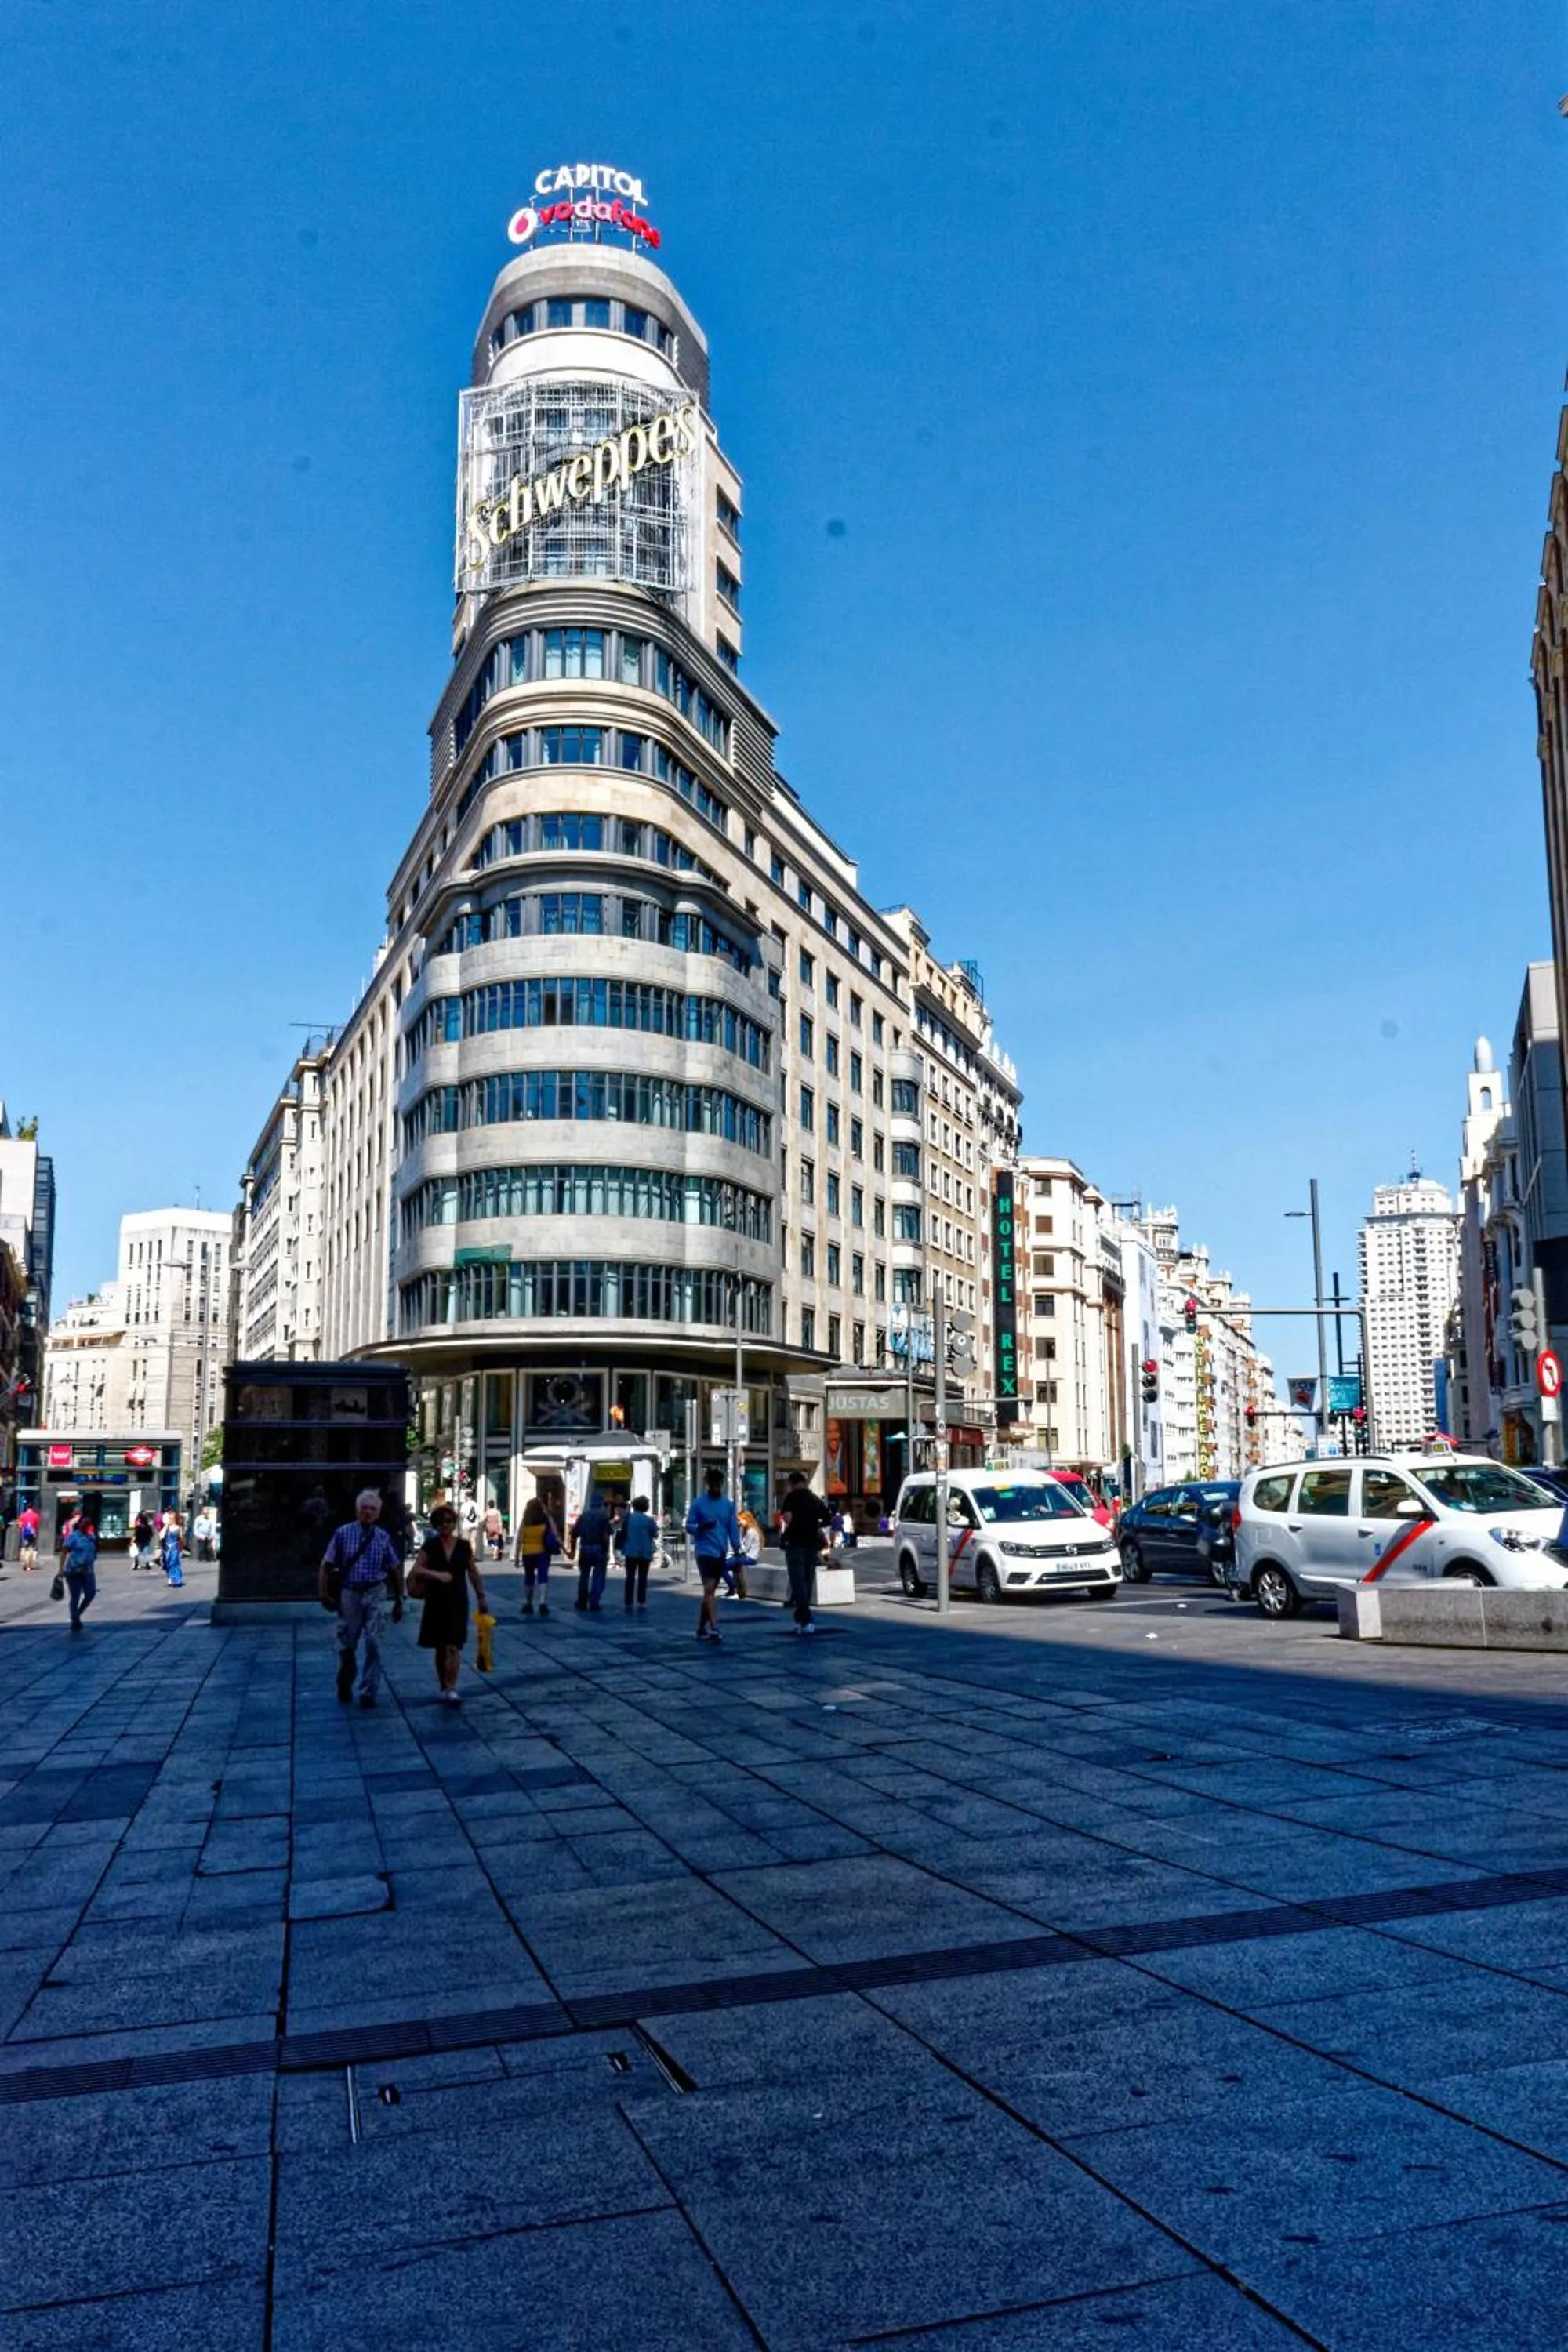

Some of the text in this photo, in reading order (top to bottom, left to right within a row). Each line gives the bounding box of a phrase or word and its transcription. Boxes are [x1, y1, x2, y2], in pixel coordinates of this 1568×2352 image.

[535, 164, 648, 206] CAPITOL
[539, 195, 662, 250] vodafone
[466, 397, 699, 572] Schweppes
[998, 1197, 1015, 1395] HOTEL REX
